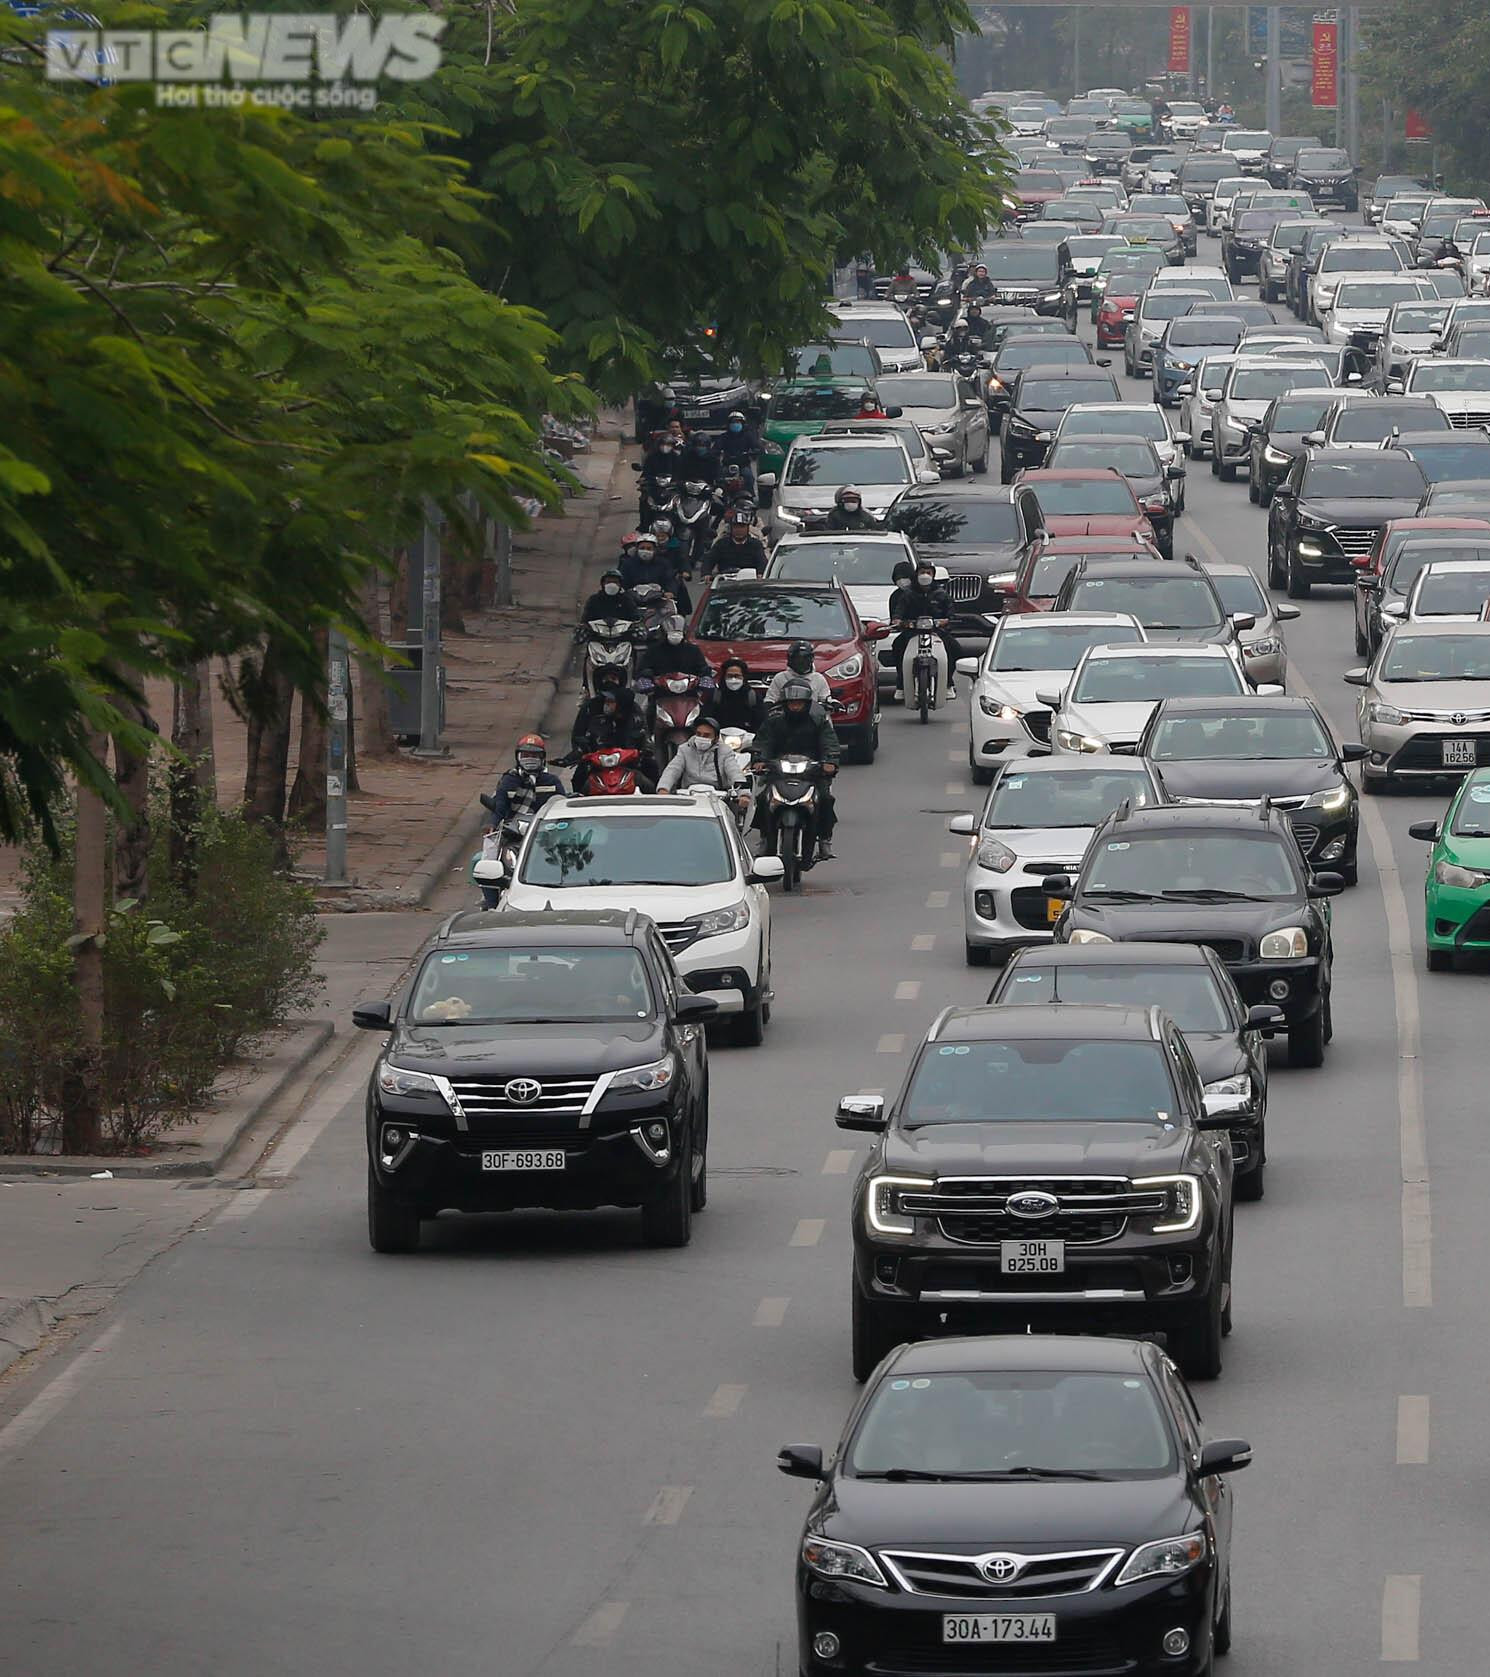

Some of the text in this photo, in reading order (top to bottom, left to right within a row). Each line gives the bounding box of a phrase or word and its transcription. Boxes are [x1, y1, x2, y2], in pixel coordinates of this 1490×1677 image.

[484, 1152, 563, 1168] 30F-693.68
[1019, 1243, 1046, 1256] 30H
[1008, 1258, 1058, 1271] 825.08
[946, 1618, 1052, 1639] 30A-173.44
